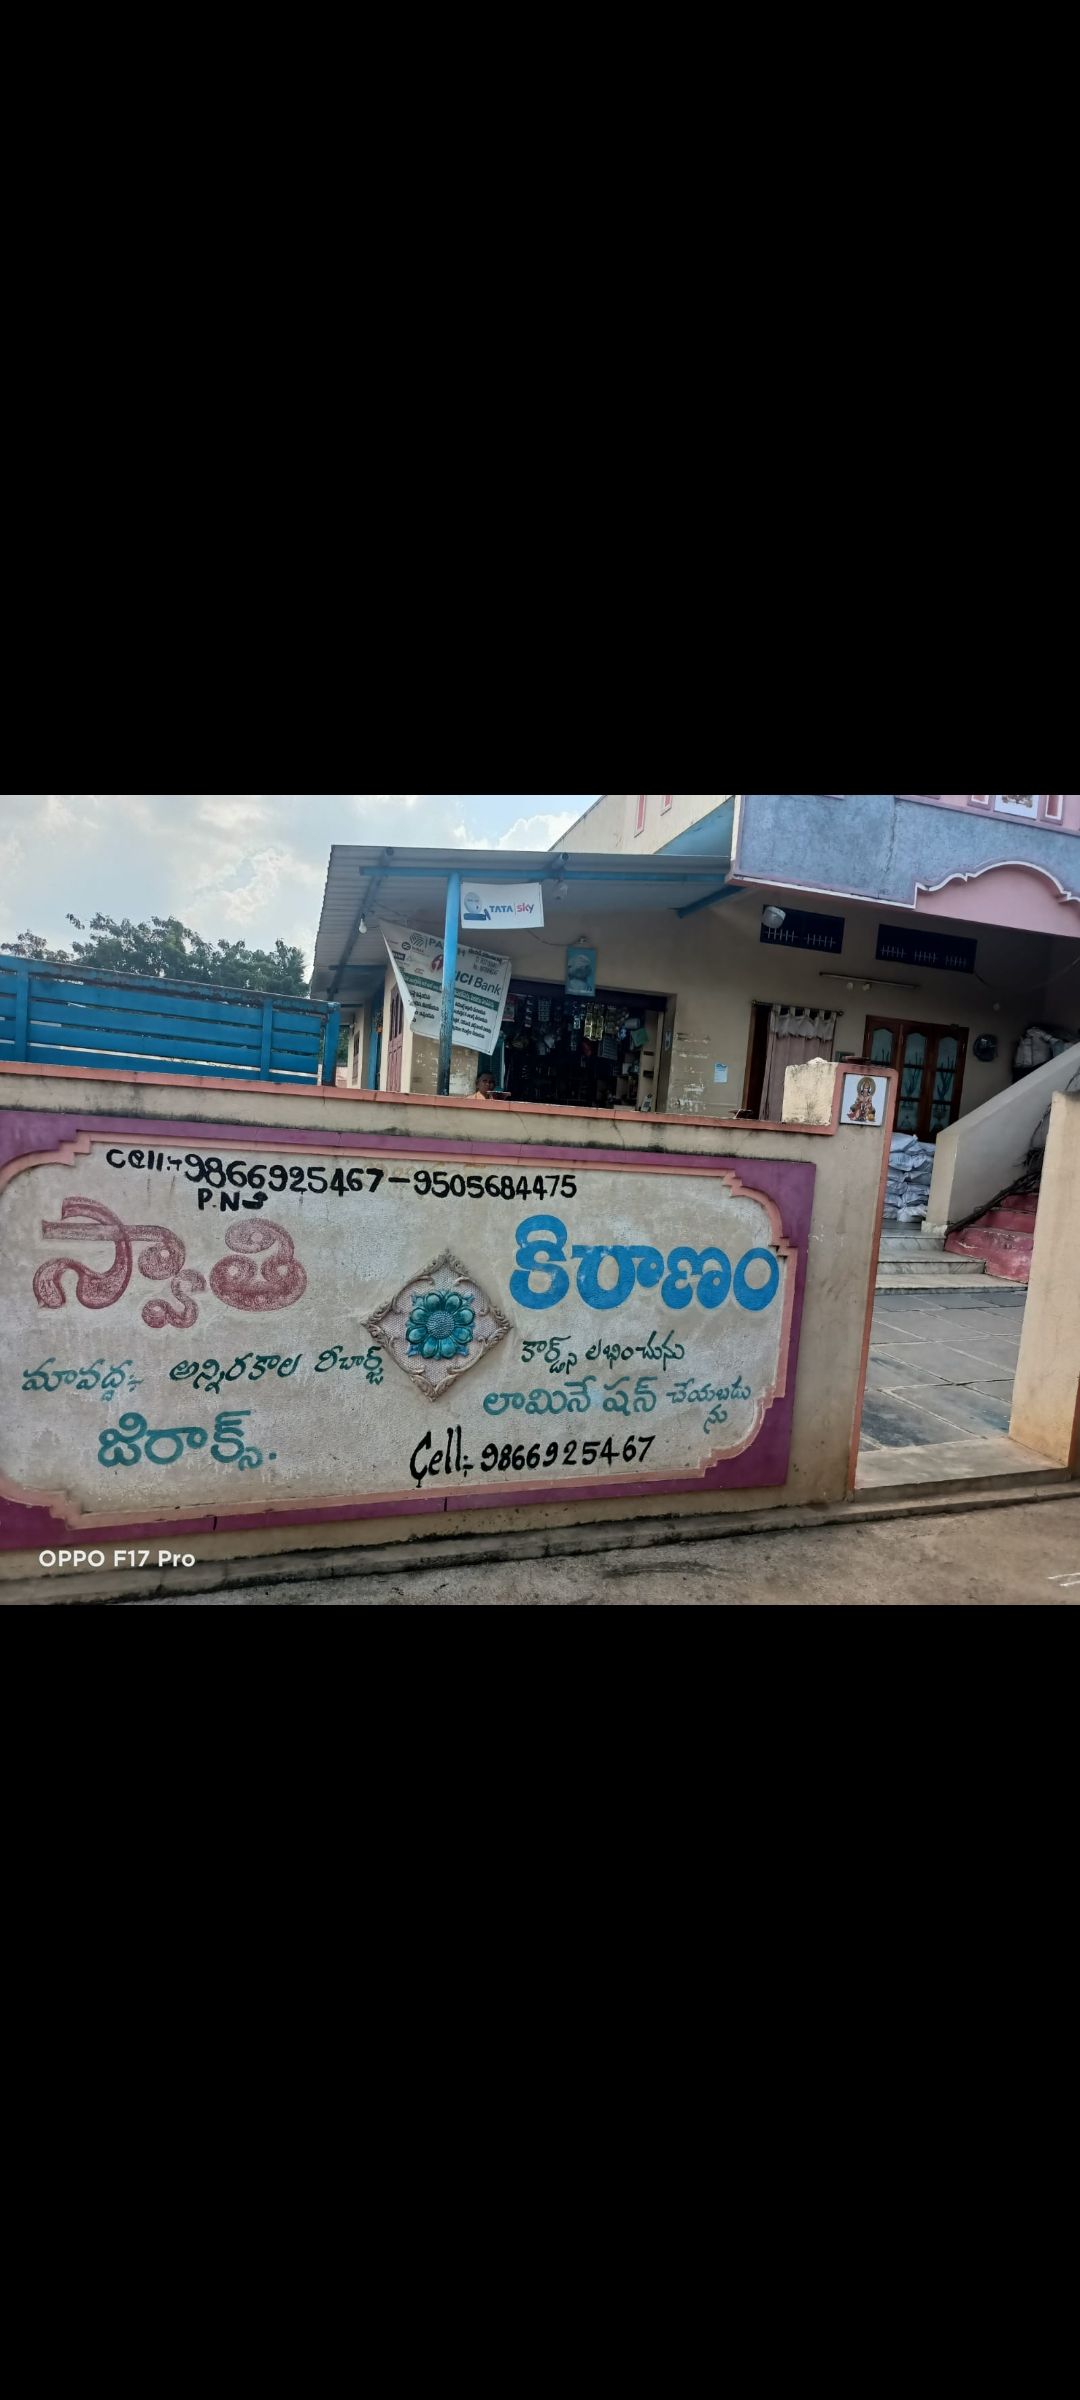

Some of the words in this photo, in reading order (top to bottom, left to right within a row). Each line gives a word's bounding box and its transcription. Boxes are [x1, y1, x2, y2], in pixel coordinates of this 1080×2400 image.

[489, 905, 513, 913] TATA
[516, 902, 534, 914] sky
[474, 977, 502, 996] Bank
[33, 1196, 308, 1329] స్వాతి
[509, 1213, 780, 1311] కిరాణం
[480, 1434, 657, 1473] 9866925467
